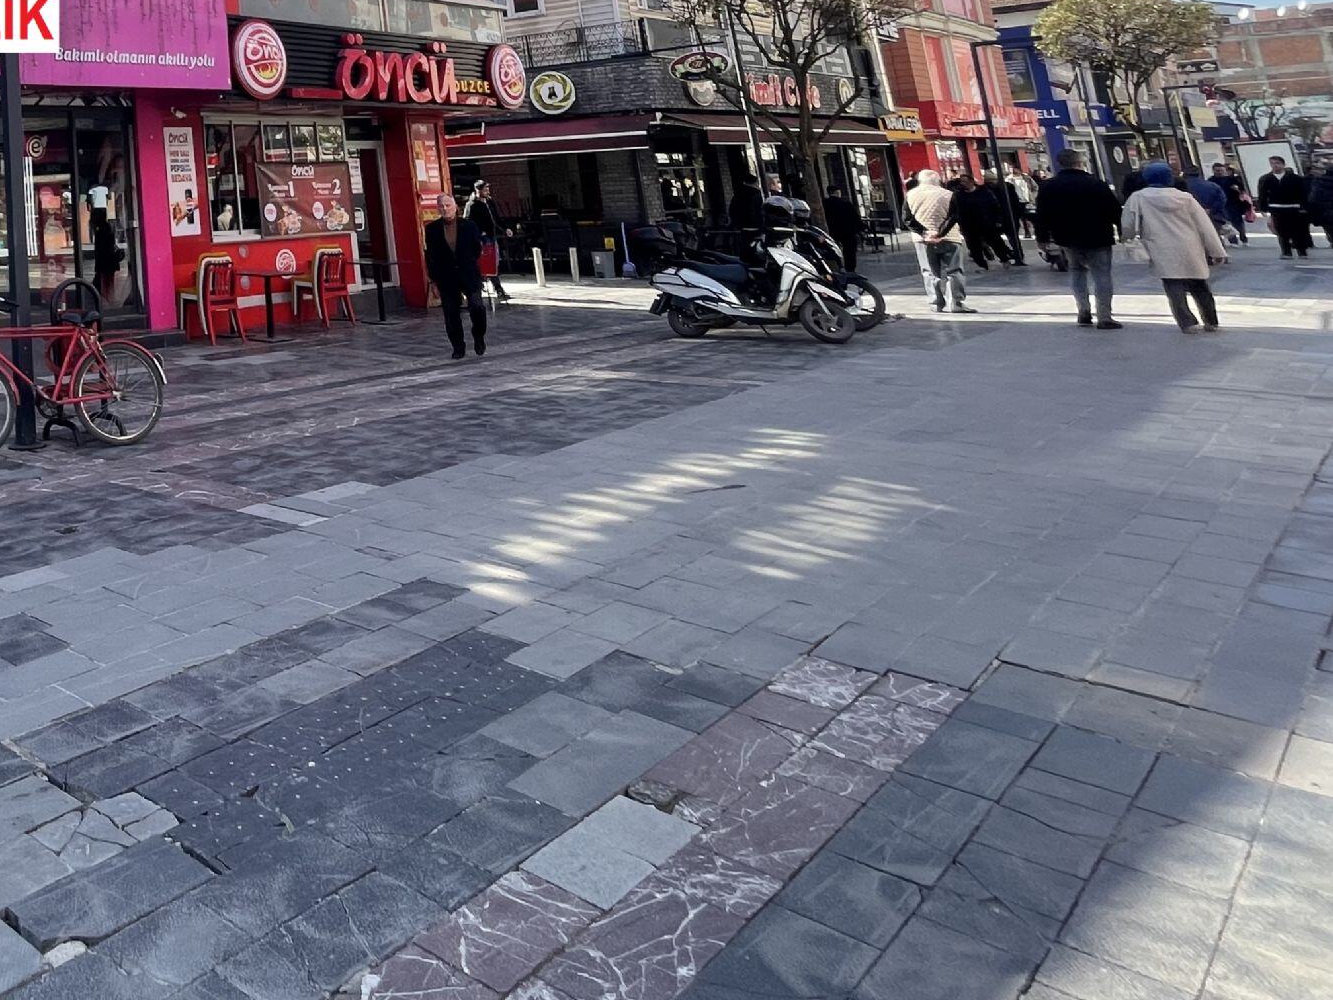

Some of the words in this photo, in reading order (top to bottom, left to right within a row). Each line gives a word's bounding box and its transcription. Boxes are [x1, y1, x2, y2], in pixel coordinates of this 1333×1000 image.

[55, 48, 104, 63] Bakımlı
[106, 49, 156, 65] olmanın
[158, 52, 189, 67] akıllı
[188, 54, 215, 69] yolu
[332, 179, 341, 194] 2
